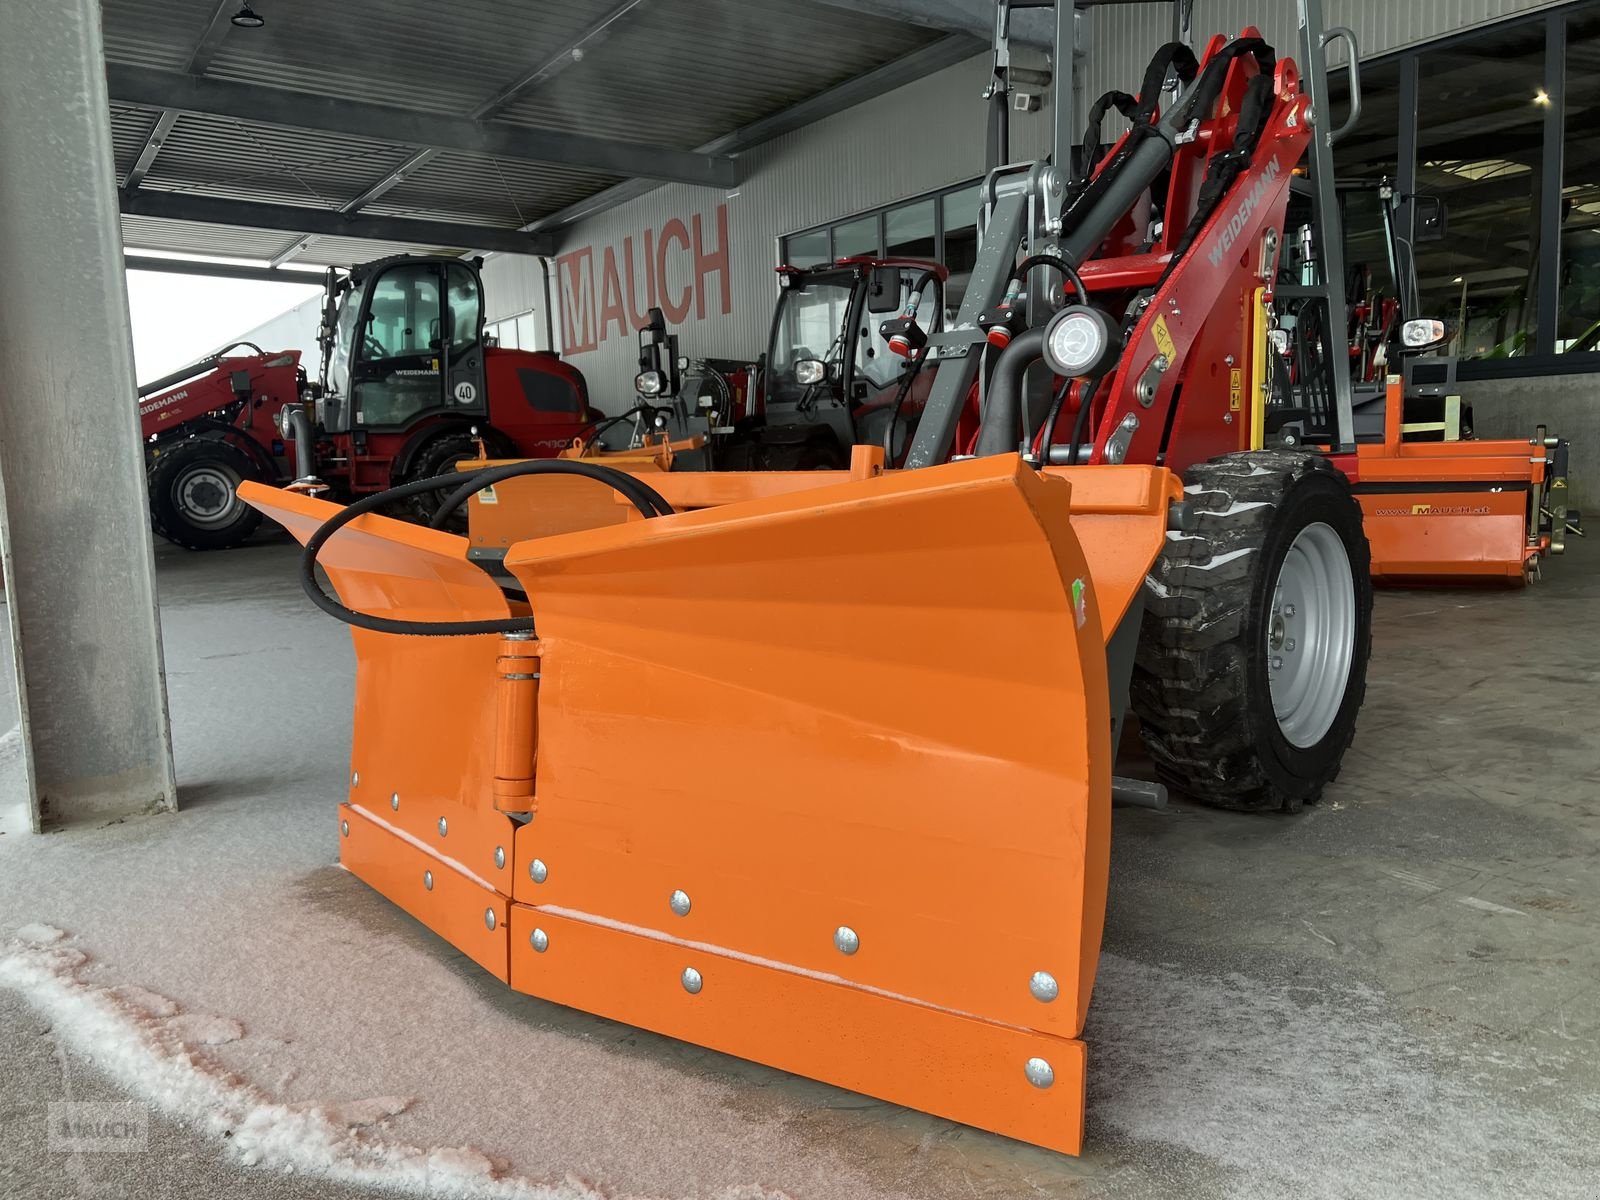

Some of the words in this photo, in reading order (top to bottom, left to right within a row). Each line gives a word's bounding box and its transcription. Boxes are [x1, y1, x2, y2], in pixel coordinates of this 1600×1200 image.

[1208, 154, 1280, 268] WEIDEMANN
[556, 203, 732, 357] MAUCH
[140, 390, 188, 415] EIDEMANN
[459, 385, 472, 400] 40
